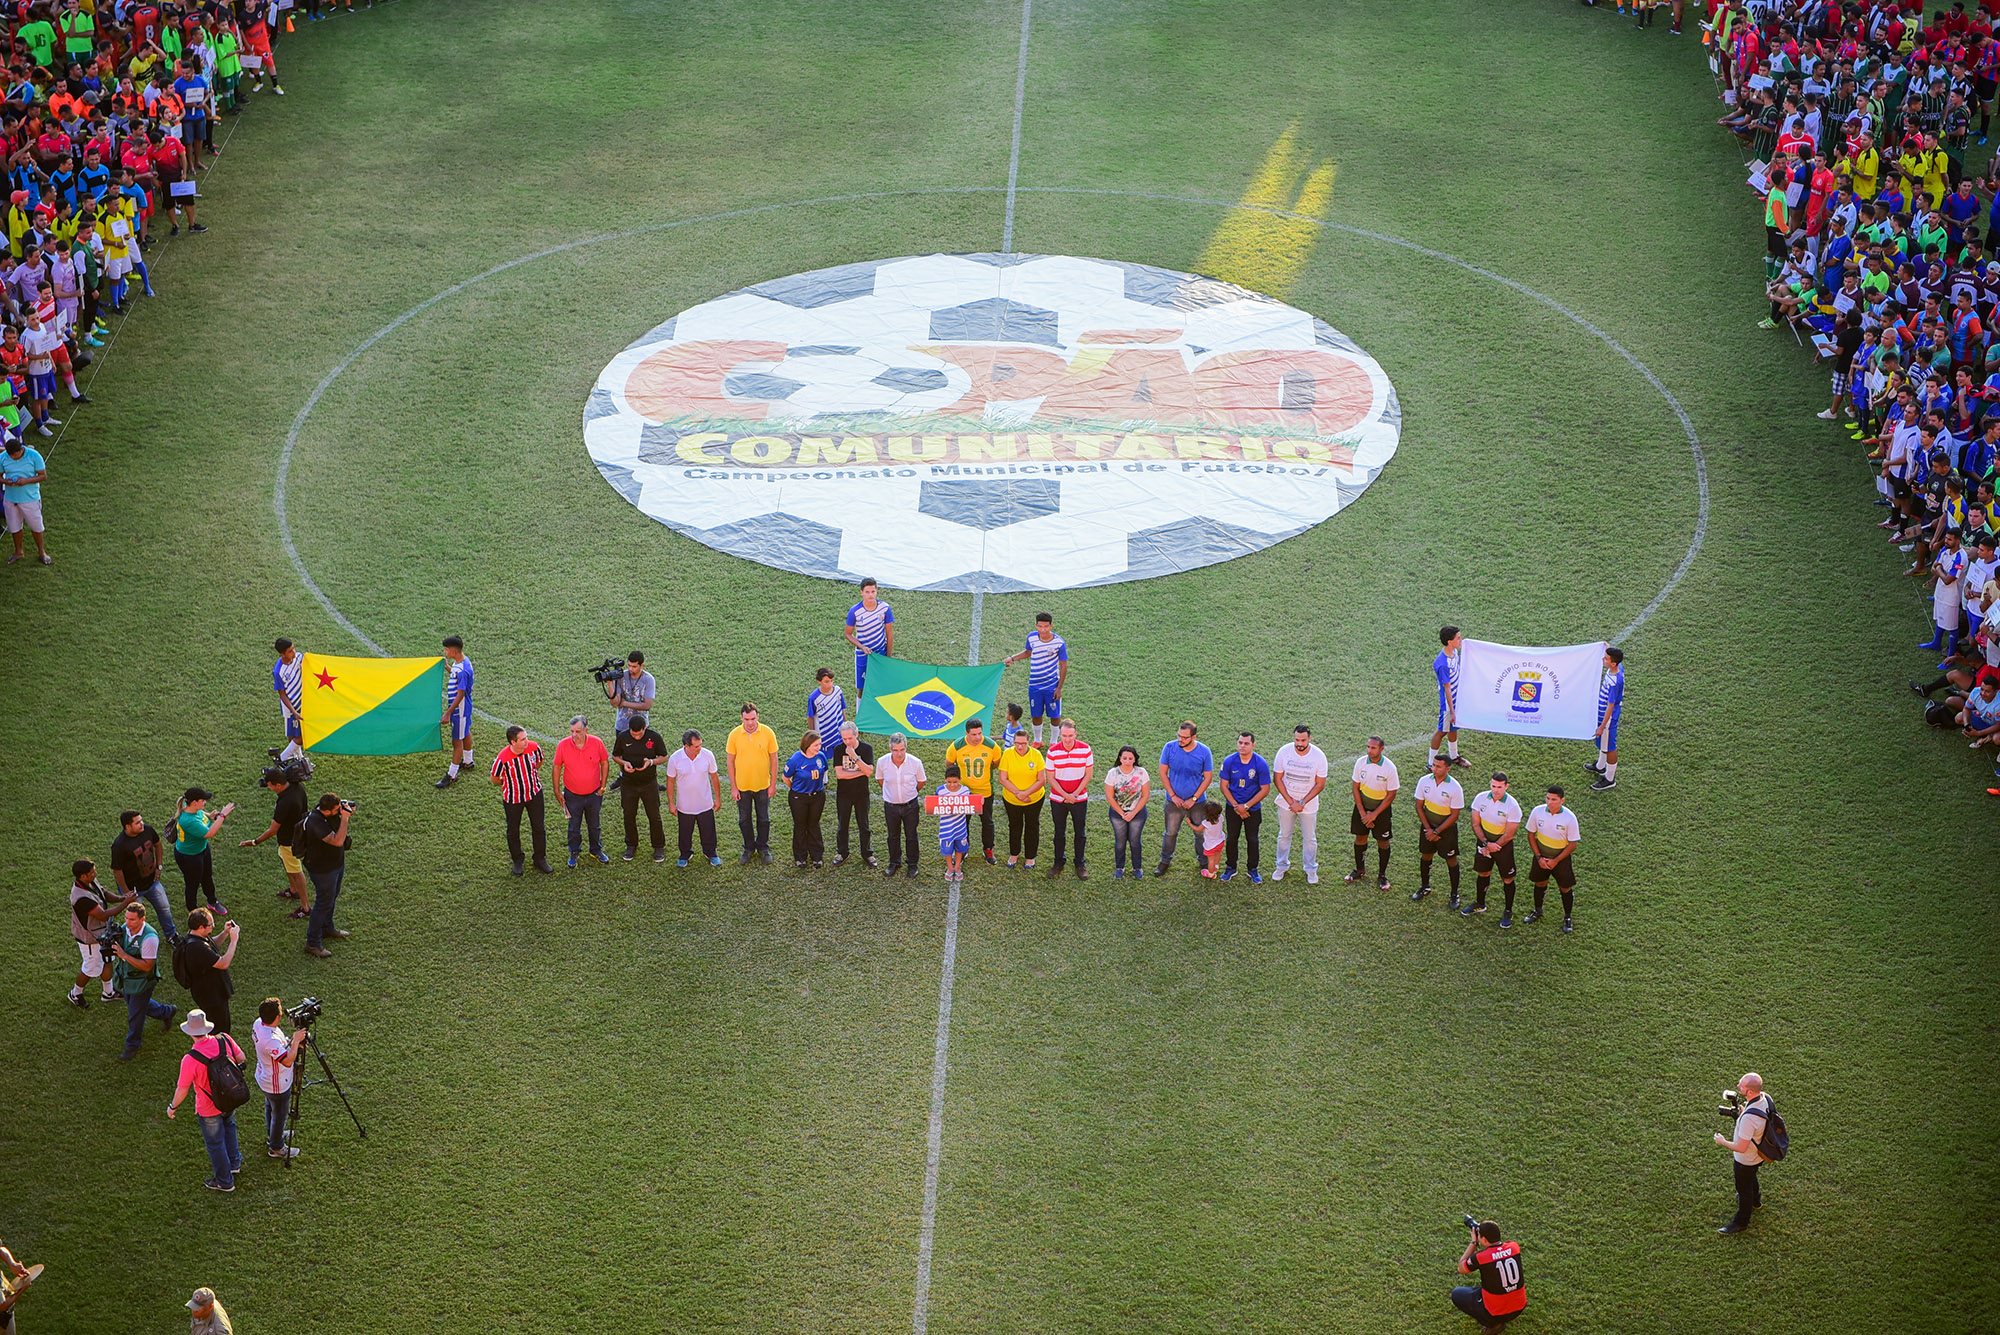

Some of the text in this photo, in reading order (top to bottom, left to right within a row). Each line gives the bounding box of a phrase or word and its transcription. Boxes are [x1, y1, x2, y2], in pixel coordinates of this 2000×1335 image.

[145, 25, 155, 39] 8
[675, 429, 1332, 464] COMUNITÁRIO
[682, 467, 918, 482] Campeonato
[931, 463, 1108, 476] Municipal
[1118, 462, 1168, 473] de
[1495, 663, 1520, 694] MUNICÍPIO
[1535, 663, 1549, 672] RIO
[1548, 671, 1561, 700] BRANCO
[811, 769, 820, 780] 10
[963, 757, 985, 778] 10
[1239, 778, 1246, 787] 10
[938, 796, 970, 805] ESCOLA
[933, 805, 976, 815] ABC ACRE
[1491, 1247, 1512, 1260] MRV
[1495, 1257, 1520, 1288] 10
